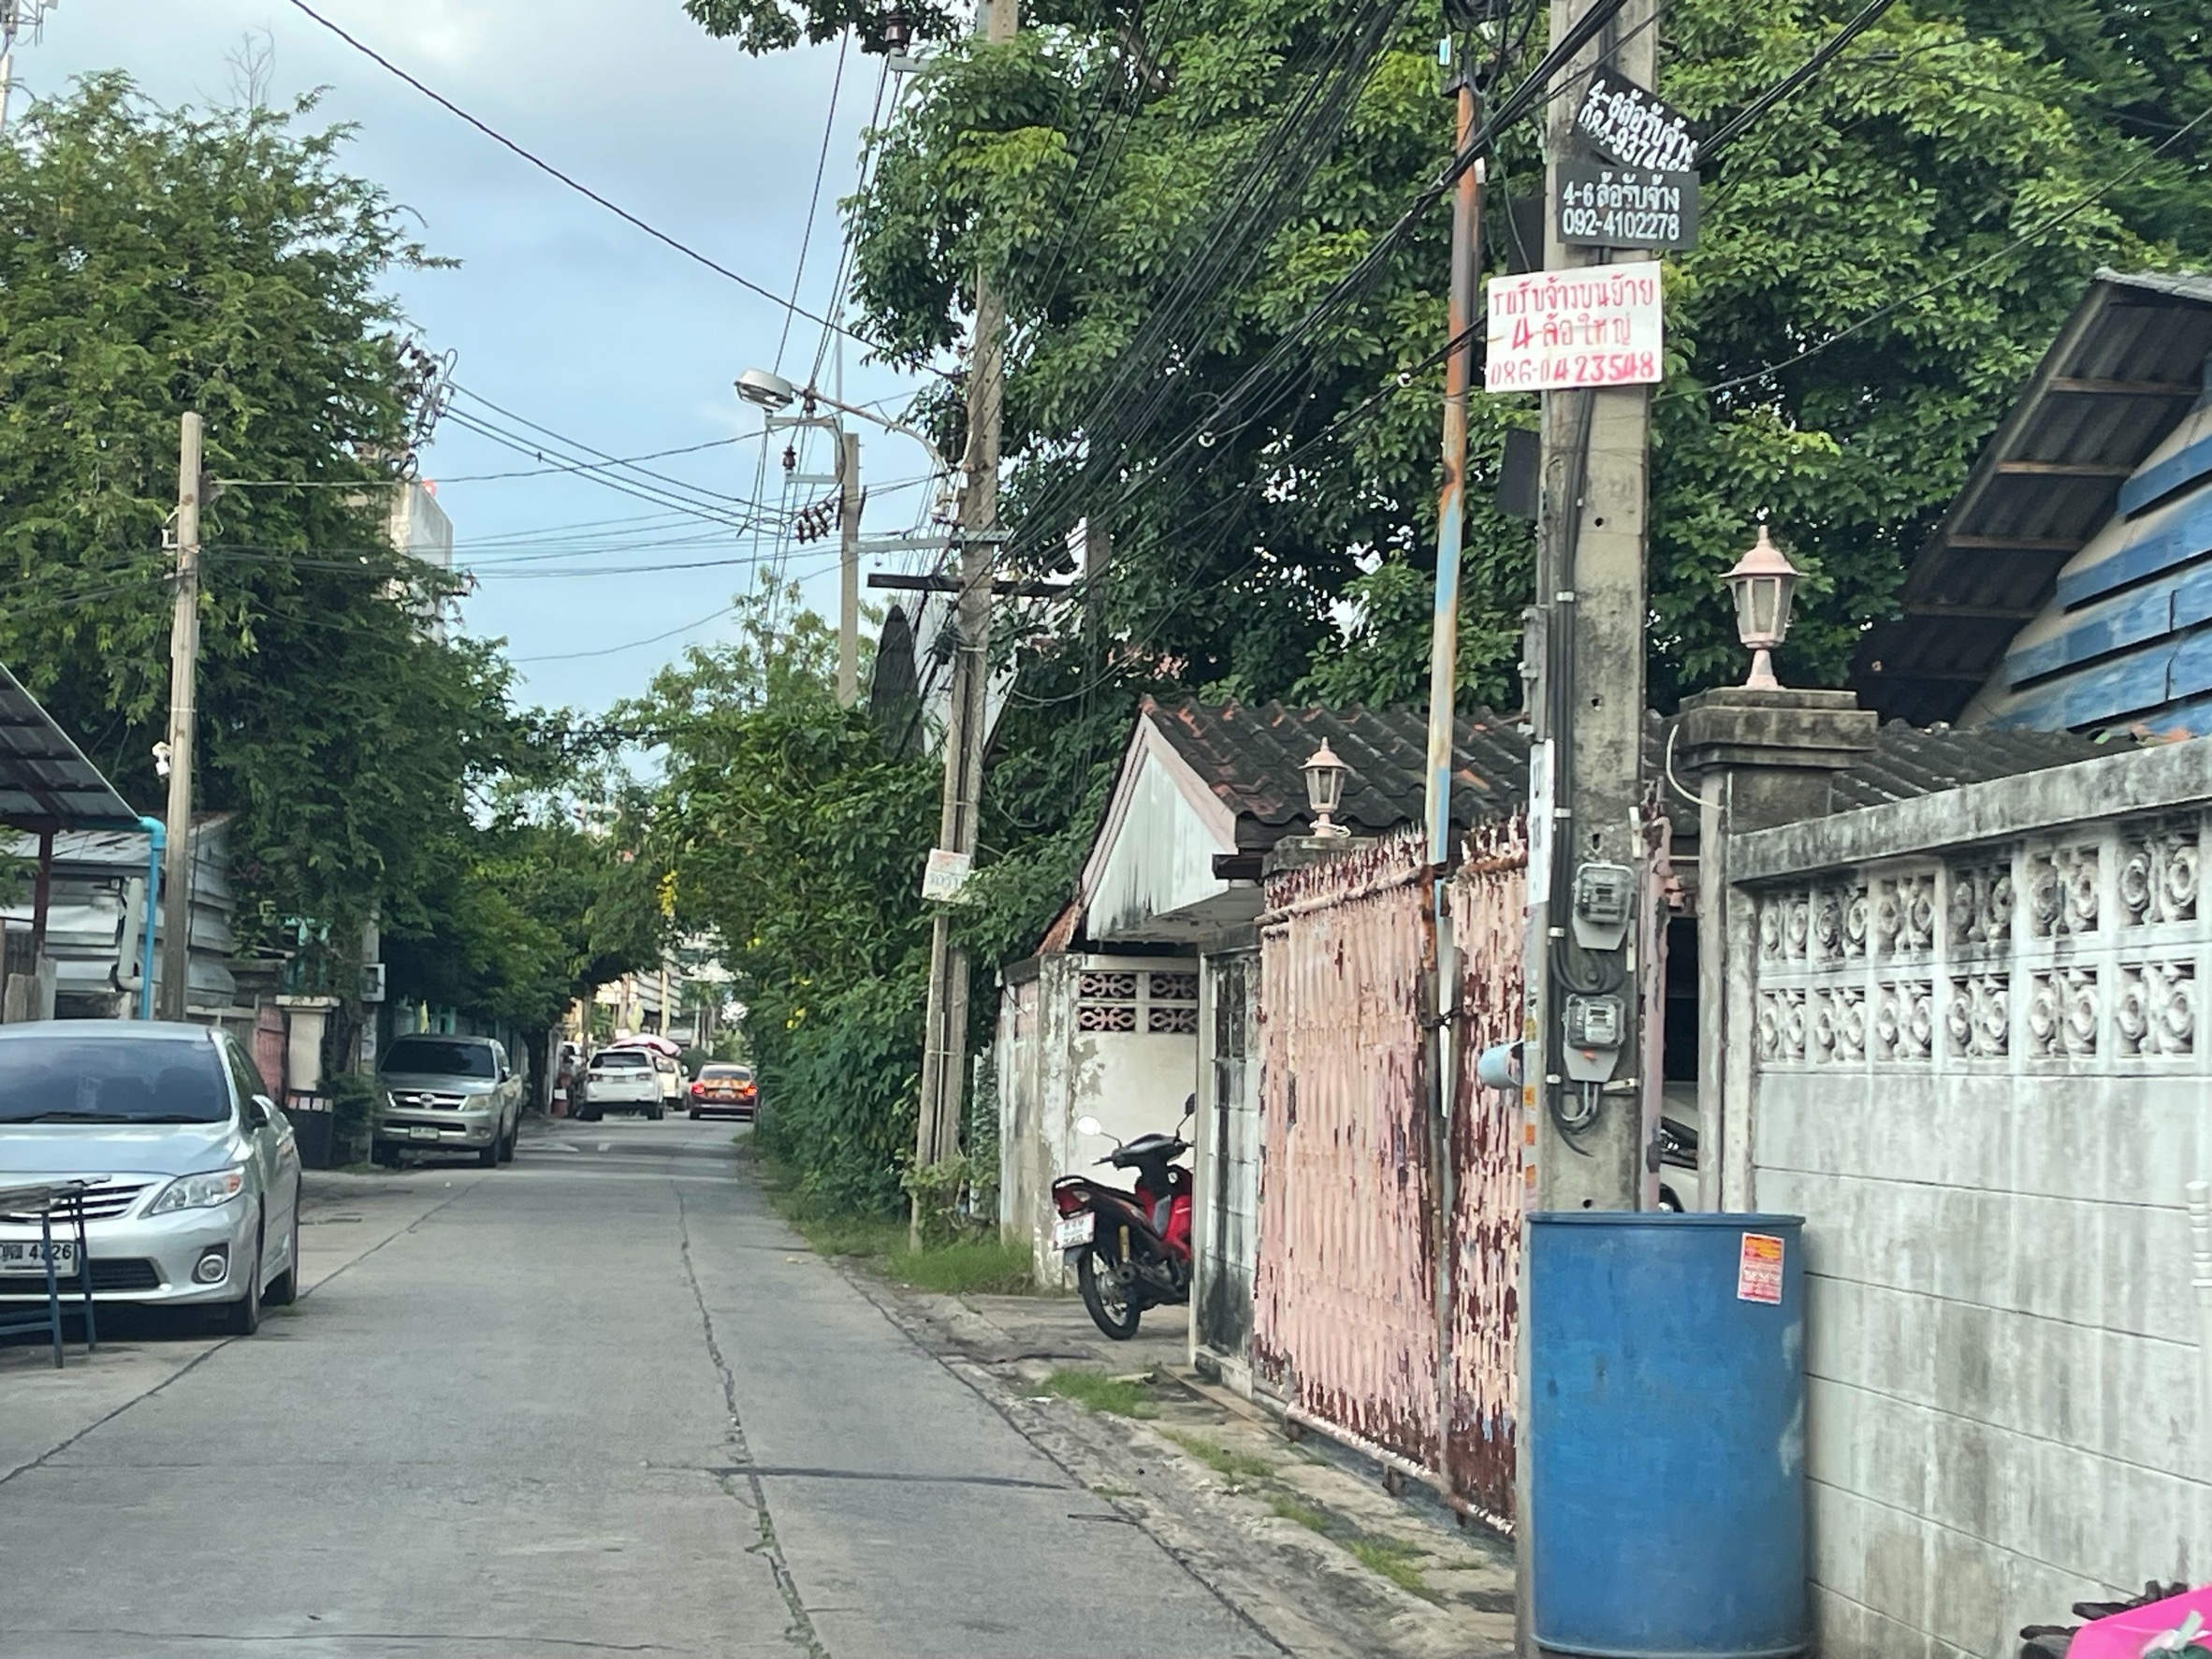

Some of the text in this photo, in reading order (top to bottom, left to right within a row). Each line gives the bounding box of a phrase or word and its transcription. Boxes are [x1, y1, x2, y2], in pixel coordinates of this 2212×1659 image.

[1562, 207, 1681, 241] 092-4102278
[1490, 351, 1655, 386] 086-0423548
[29, 1243, 72, 1261] 426
